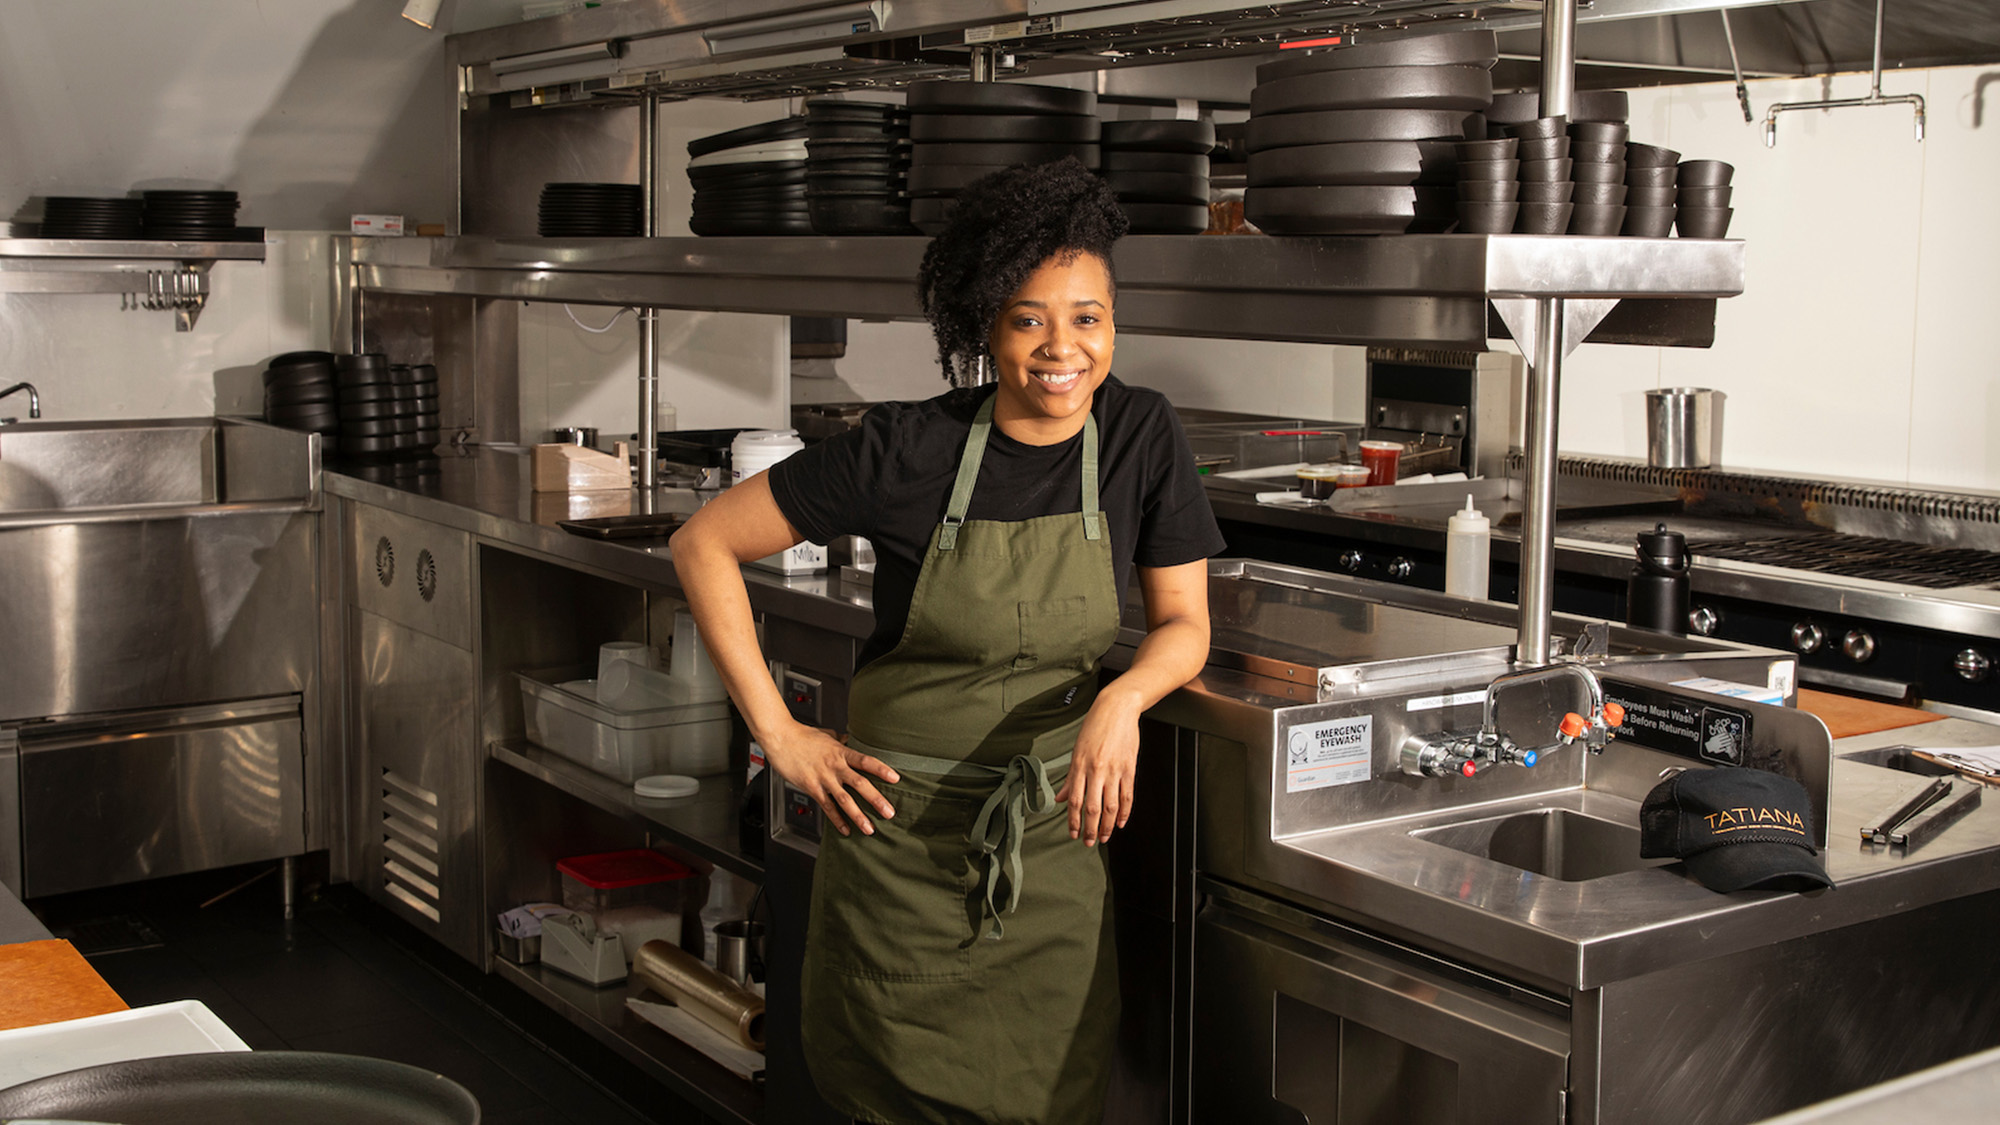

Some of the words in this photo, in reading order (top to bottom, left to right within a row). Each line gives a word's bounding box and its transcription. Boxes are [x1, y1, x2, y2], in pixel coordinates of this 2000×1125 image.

[1604, 694, 1648, 713] Employees
[1649, 705, 1670, 719] Must
[1671, 710, 1695, 725] Wash
[1315, 724, 1368, 740] EMERGENCY
[1630, 713, 1657, 729] Before
[1659, 721, 1700, 741] Returning
[1320, 735, 1362, 748] EYEWASH
[1704, 807, 1805, 829] TATIANA
